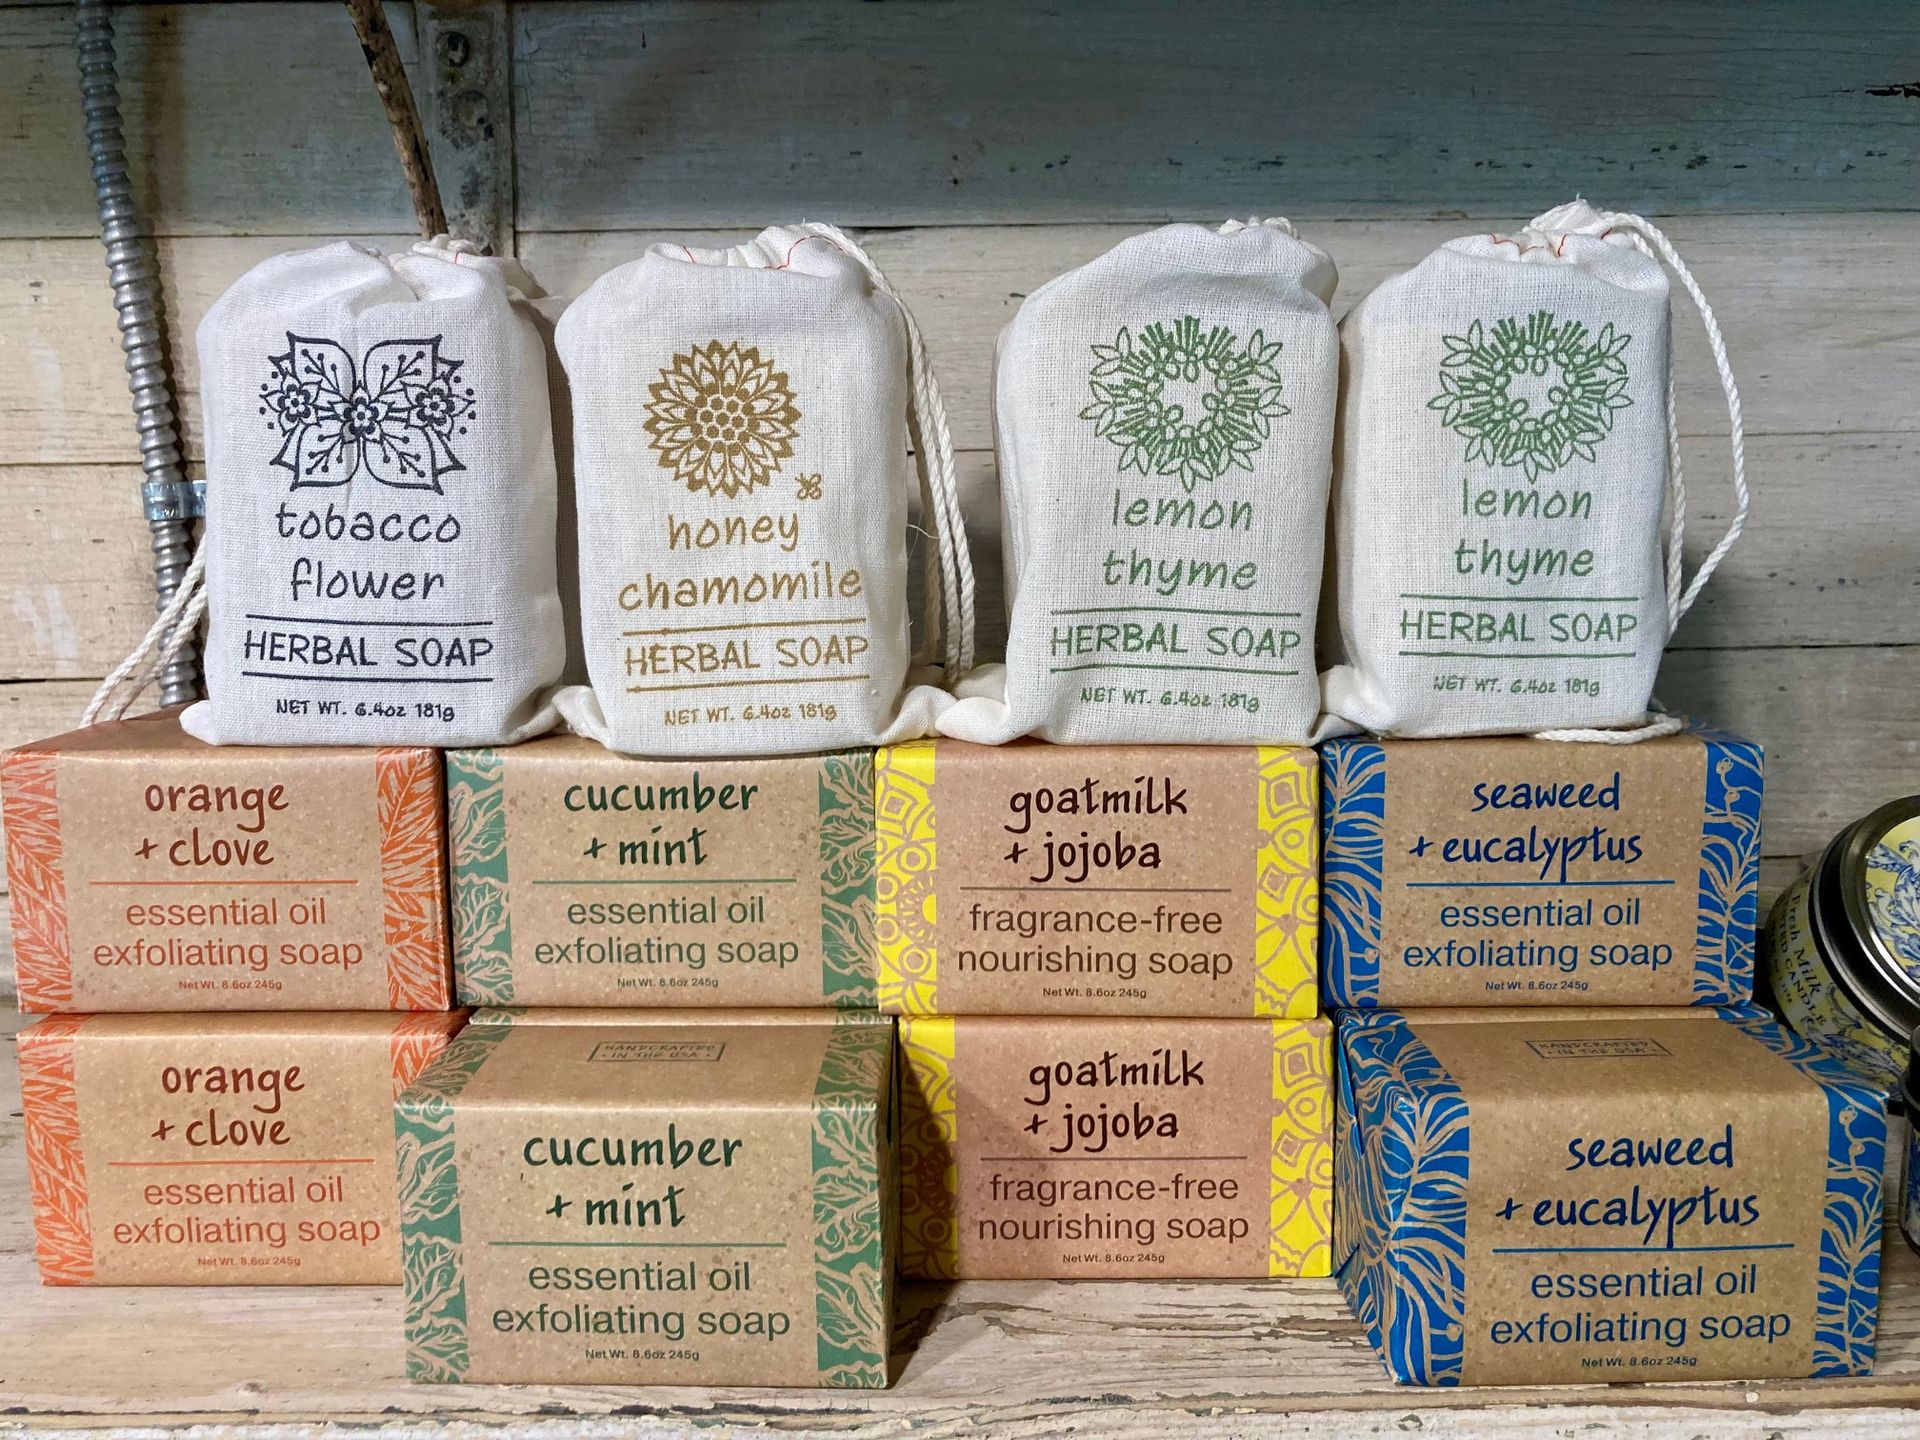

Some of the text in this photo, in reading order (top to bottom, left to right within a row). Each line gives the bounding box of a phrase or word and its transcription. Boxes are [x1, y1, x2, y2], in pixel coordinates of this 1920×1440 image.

[1112, 489, 1252, 530] lemon
[1462, 478, 1592, 519] lemon
[276, 501, 461, 542] tobacco
[668, 512, 799, 551] honey
[291, 557, 444, 600] flower
[1103, 548, 1258, 596] thyme
[1455, 539, 1594, 585] thyme
[618, 560, 862, 610] chamomile
[1051, 623, 1301, 658] HERBAL SOAP
[1400, 609, 1638, 642] HERBAL SOAP
[244, 629, 493, 666] HERBAL SOAP
[624, 635, 869, 676] HERBAL SOAP
[1081, 687, 1116, 702] NET
[1123, 688, 1151, 704] WT.
[1433, 675, 1600, 696] NET WT. 6.4oz 181g
[276, 699, 455, 721] NET WT. 6.4oz 181g
[664, 703, 837, 726] NET WT. 6.4oz 181g
[144, 783, 289, 833] orange
[564, 770, 759, 814] cucumber
[1003, 775, 1188, 833] goatmilk
[1471, 771, 1621, 812] seaweed
[134, 826, 274, 866] + clove
[583, 825, 708, 866] + mint
[1003, 830, 1162, 883] + jojoba
[1409, 825, 1644, 883] + eucalyptus
[126, 897, 326, 926] essential oil
[567, 895, 765, 924] essential oil
[969, 903, 1223, 938] fragrance-free
[1440, 898, 1640, 927] essential oil
[93, 938, 363, 972] exfoliating soap
[535, 936, 799, 969] exfoliating soap
[958, 944, 1233, 980] nourishing soap
[1403, 940, 1673, 973] exfoliating soap
[1789, 895, 1821, 998] Fresh Milk
[178, 980, 283, 991] Net Wt. 8.6oz 245g
[617, 977, 719, 988] Net Wt. 8.6oz 245g
[1043, 987, 1147, 999] Net Wt. 8.6oz 245g
[1485, 981, 1588, 991] Net Wt. 8.6oz 245g
[161, 1065, 305, 1114] orange
[1023, 1048, 1204, 1105] goatmilk
[151, 1109, 291, 1147] + clove
[1023, 1102, 1179, 1153] + jojoba
[523, 1123, 743, 1169] cucumber
[1566, 1123, 1734, 1171] seaweed
[143, 1176, 343, 1205] essential oil
[546, 1182, 686, 1227] + mint
[989, 1173, 1239, 1207] fragrance-free
[112, 1216, 381, 1248] exfoliating soap
[978, 1213, 1250, 1246] nourishing soap
[1495, 1185, 1760, 1249] + eucalyptus
[197, 1257, 301, 1266] Net Wt. 8.6oz 245g
[528, 1261, 750, 1291] essential oil
[1063, 1254, 1165, 1264] Net Wt. 8.6oz 245g
[1531, 1264, 1757, 1299] essential oil
[492, 1303, 791, 1341] exfoliating soap
[1490, 1312, 1791, 1347] exfoliating soap
[585, 1350, 699, 1361] Net Wt. 8.6oz 245g
[1582, 1356, 1698, 1367] Net Wt. 8.6oz 245g
